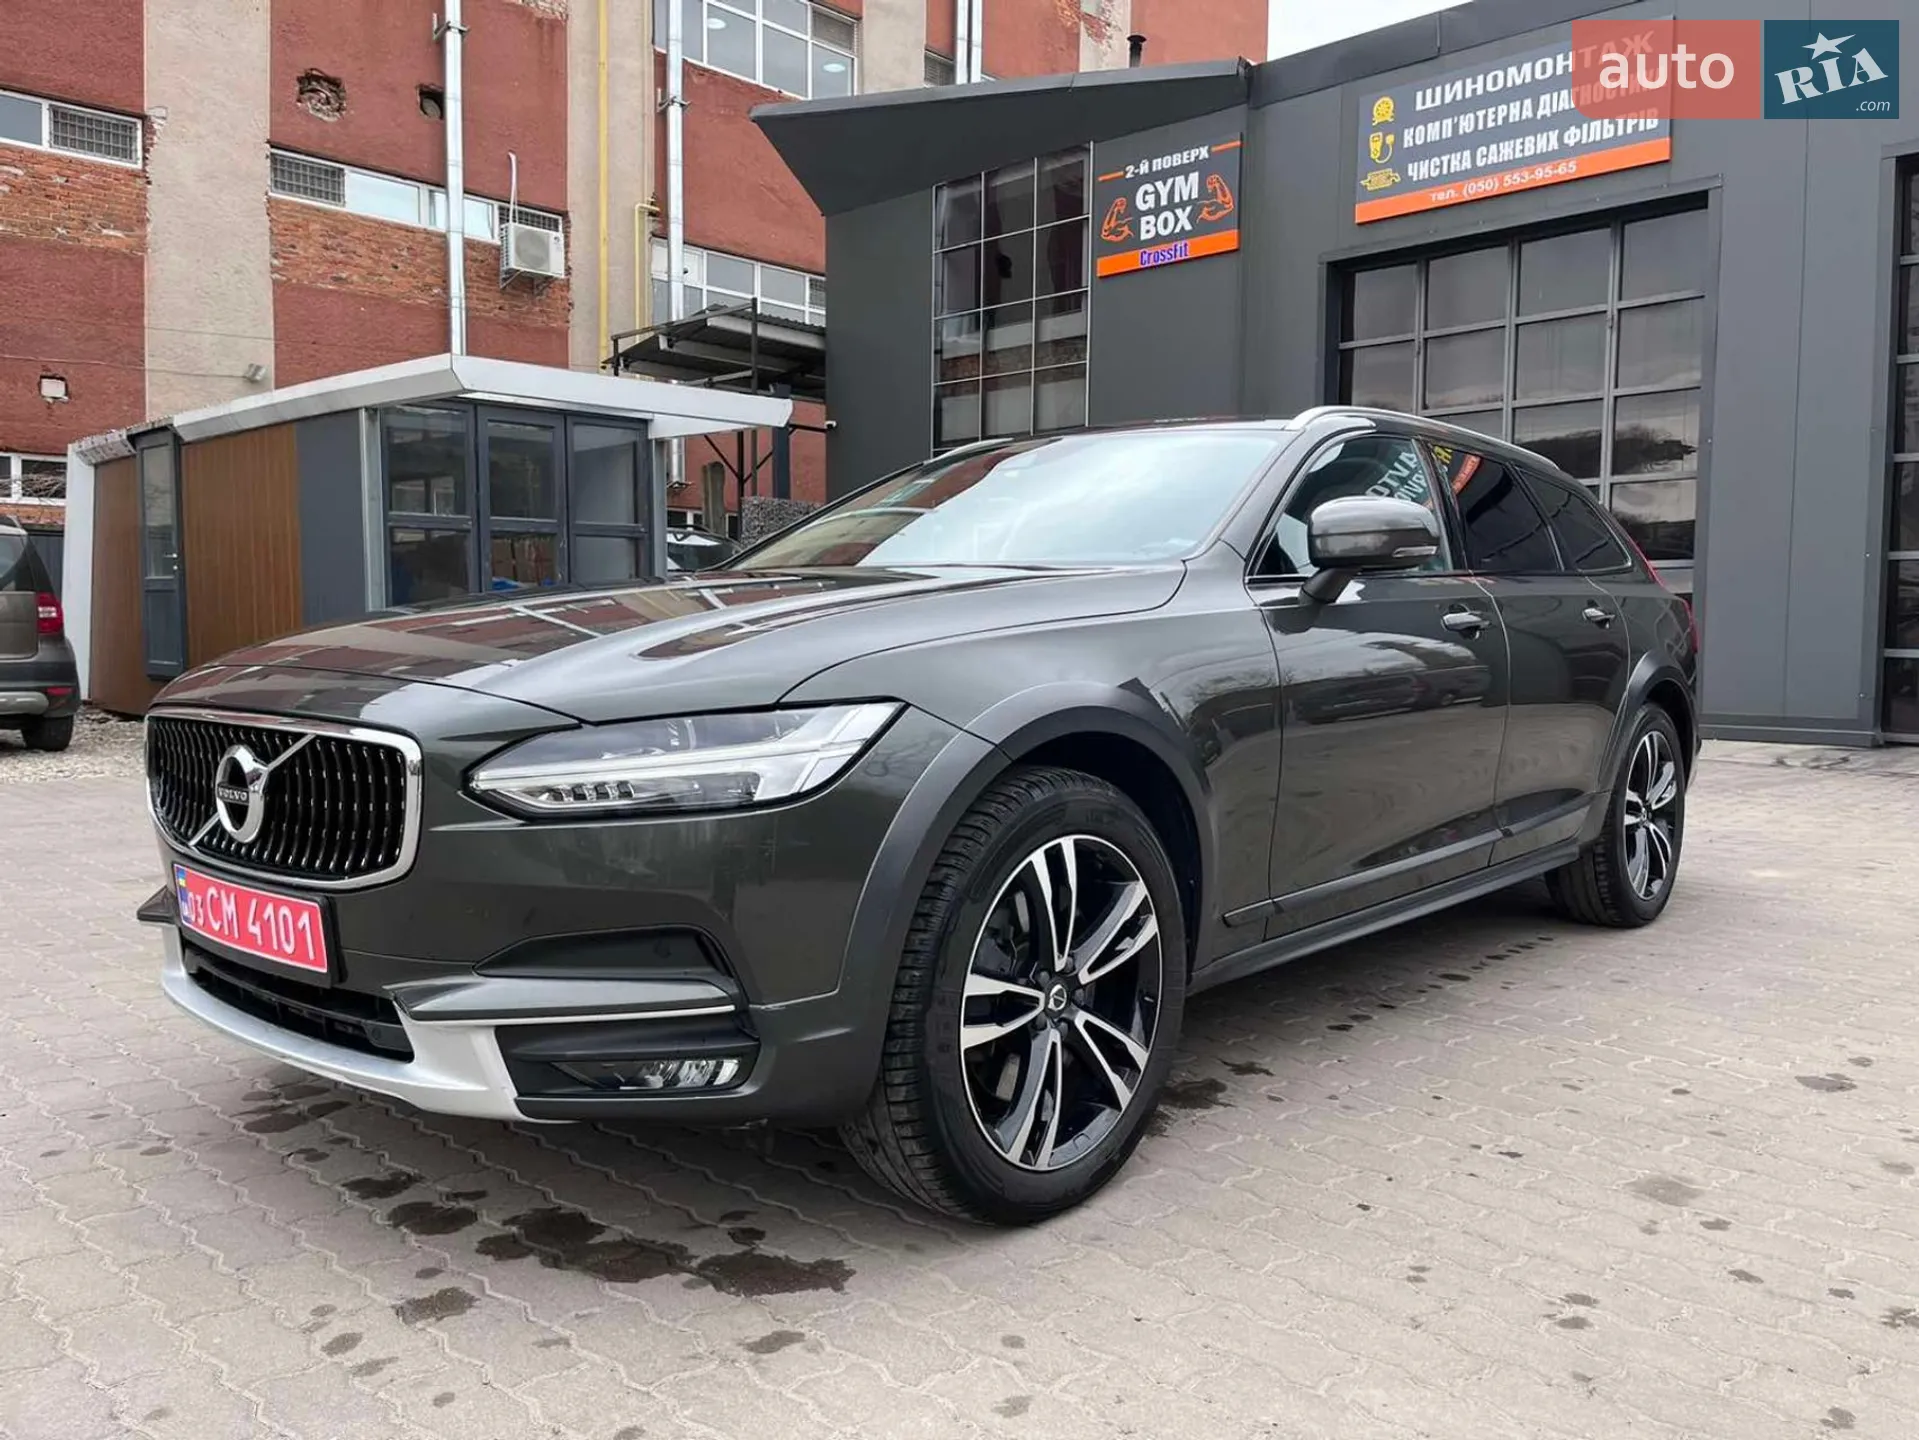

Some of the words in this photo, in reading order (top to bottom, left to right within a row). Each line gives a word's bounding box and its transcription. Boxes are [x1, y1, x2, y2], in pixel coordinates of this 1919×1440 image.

[1403, 98, 1533, 148] КОМП'ЮТЕРНА
[1152, 145, 1209, 172] ПОВЕРХ
[1407, 149, 1471, 182] ЧИСТКА
[1475, 129, 1559, 167] САЖЕВИХ
[1563, 107, 1659, 147] ФІЛЬТРІВ
[1135, 171, 1199, 211] GYM
[1462, 178, 1499, 199] (050)
[1503, 160, 1578, 187] 553-95-65
[1140, 205, 1193, 241] BOX
[218, 787, 247, 801] VOLVO
[247, 898, 315, 961] 4101
